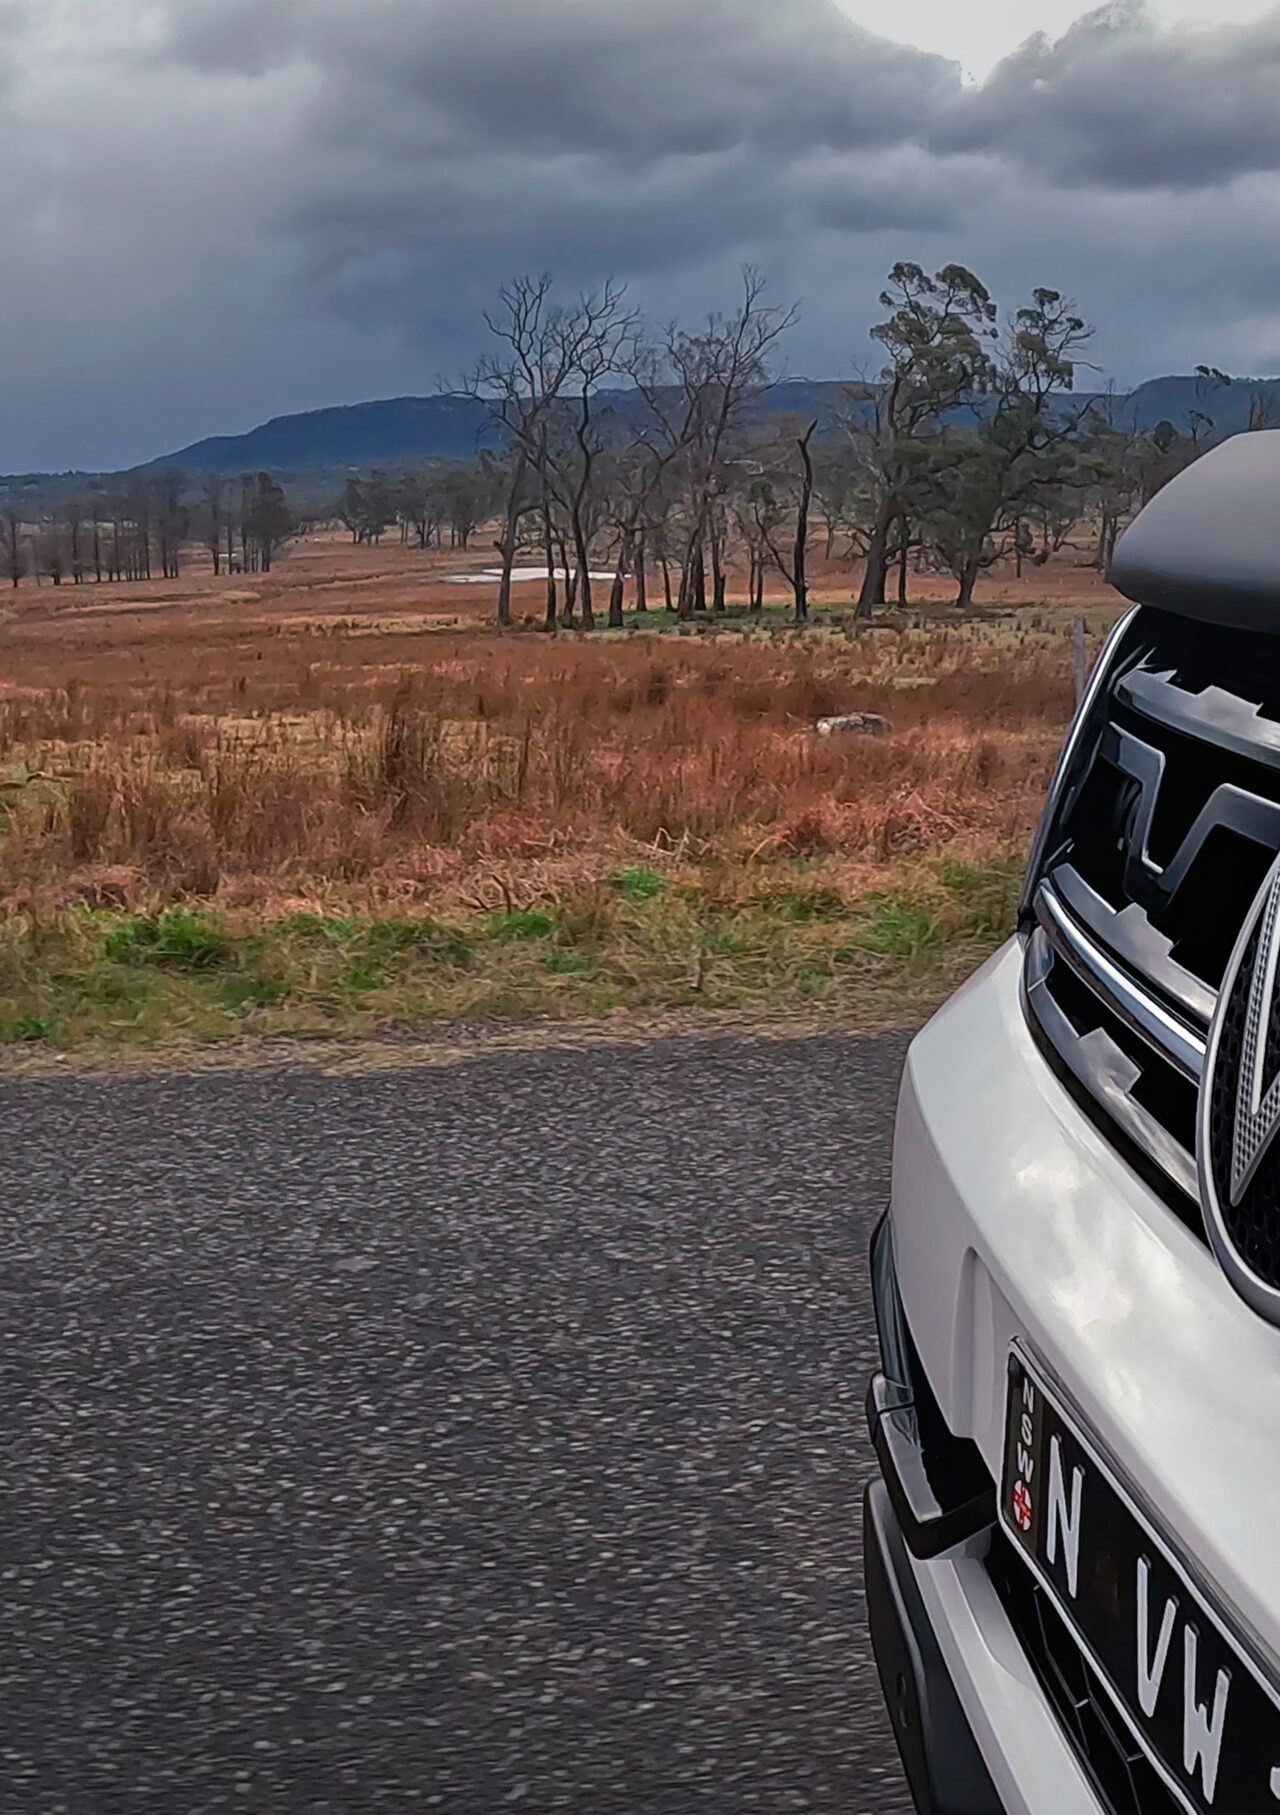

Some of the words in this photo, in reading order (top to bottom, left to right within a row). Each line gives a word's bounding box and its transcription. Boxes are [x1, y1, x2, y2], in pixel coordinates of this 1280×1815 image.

[1016, 1377, 1034, 1483] NSW
[1046, 1433, 1086, 1599] N
[1136, 1556, 1230, 1805] VW
